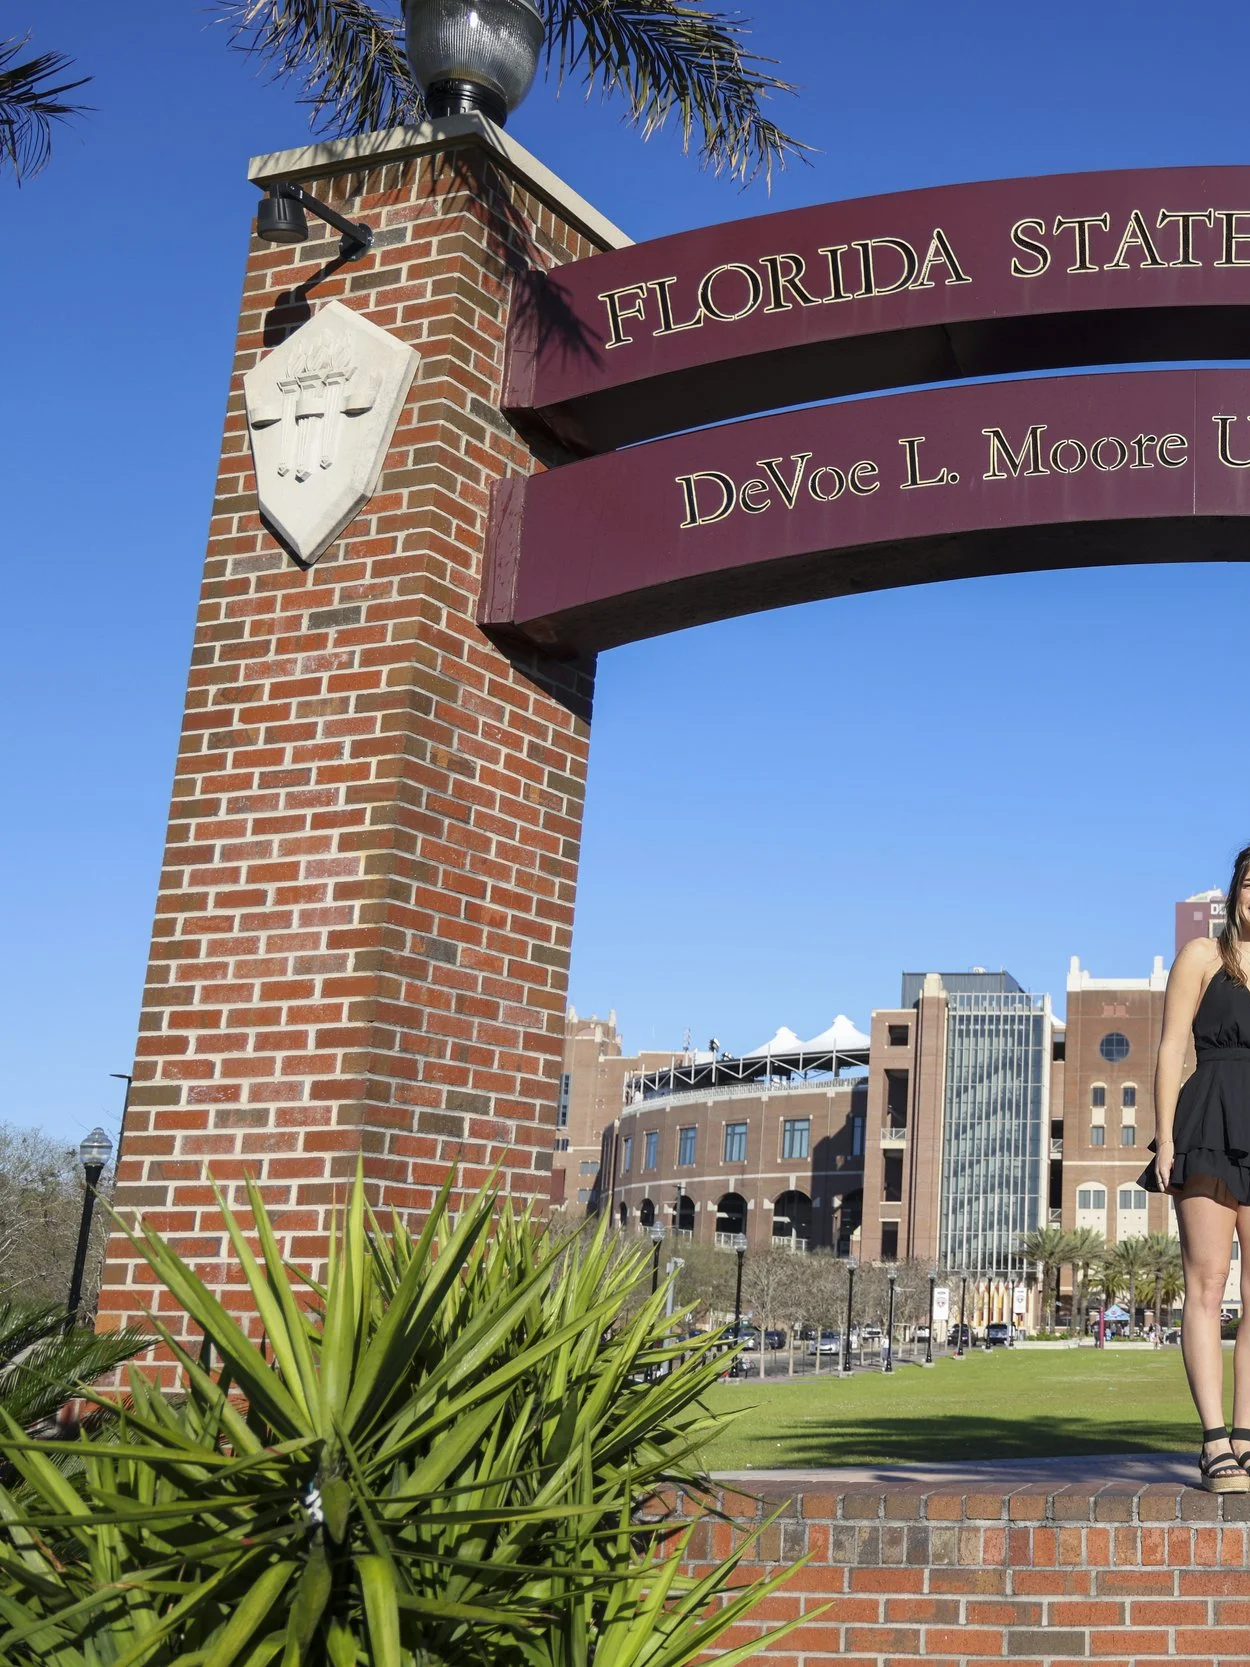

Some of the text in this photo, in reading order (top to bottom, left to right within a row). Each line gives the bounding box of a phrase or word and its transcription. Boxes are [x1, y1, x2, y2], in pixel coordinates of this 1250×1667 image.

[597, 228, 972, 350] FLORIDA
[674, 451, 880, 529] DeVoe
[898, 435, 960, 490] L.
[982, 424, 1188, 481] Moore
